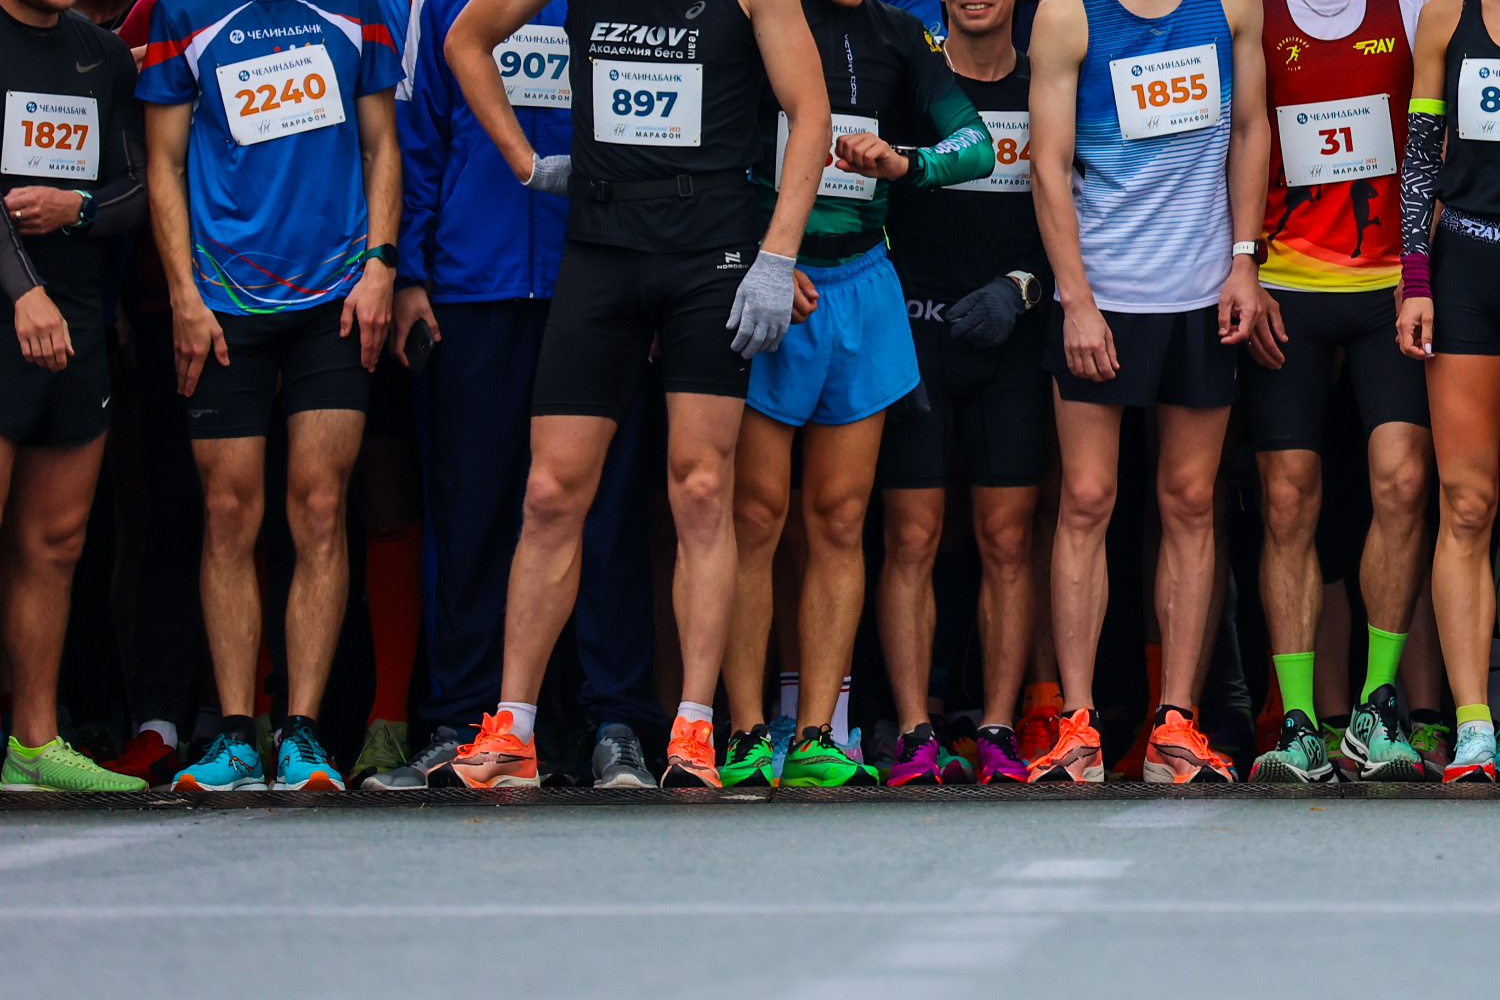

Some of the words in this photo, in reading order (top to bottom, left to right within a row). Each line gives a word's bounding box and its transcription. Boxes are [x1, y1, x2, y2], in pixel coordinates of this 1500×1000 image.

[247, 23, 322, 40] ЧЕЛИНДБАНК
[512, 34, 569, 46] ЧЕЛИНДБАН
[589, 42, 651, 56] Академия
[654, 47, 684, 59] бега
[688, 29, 699, 59] Team
[1354, 37, 1396, 56] RAY
[844, 33, 853, 74] VICTORY
[252, 56, 313, 77] ЧЕЛИНДБАНК
[500, 50, 570, 80] 907
[1145, 56, 1202, 73] ЧЕЛИНДБАНК
[621, 72, 683, 83] ЧЕЛИНДБАНК
[234, 72, 326, 118] 2240
[524, 92, 570, 102] МАРАФОН
[1131, 73, 1208, 110] 1855
[40, 104, 88, 116] ЧЕЛИНДБАНК
[612, 88, 679, 118] 897
[281, 113, 327, 129] МАРАФОН
[1170, 114, 1209, 126] МАРАФОН
[1309, 106, 1371, 122] ЧЕЛИНДБАНК
[21, 120, 89, 151] 1827
[635, 131, 681, 139] МАРАФОН
[1318, 126, 1354, 156] 31
[49, 163, 86, 172] МАРАФОН
[1333, 163, 1378, 176] МАРАФОН
[824, 182, 864, 192] МАРАФОН
